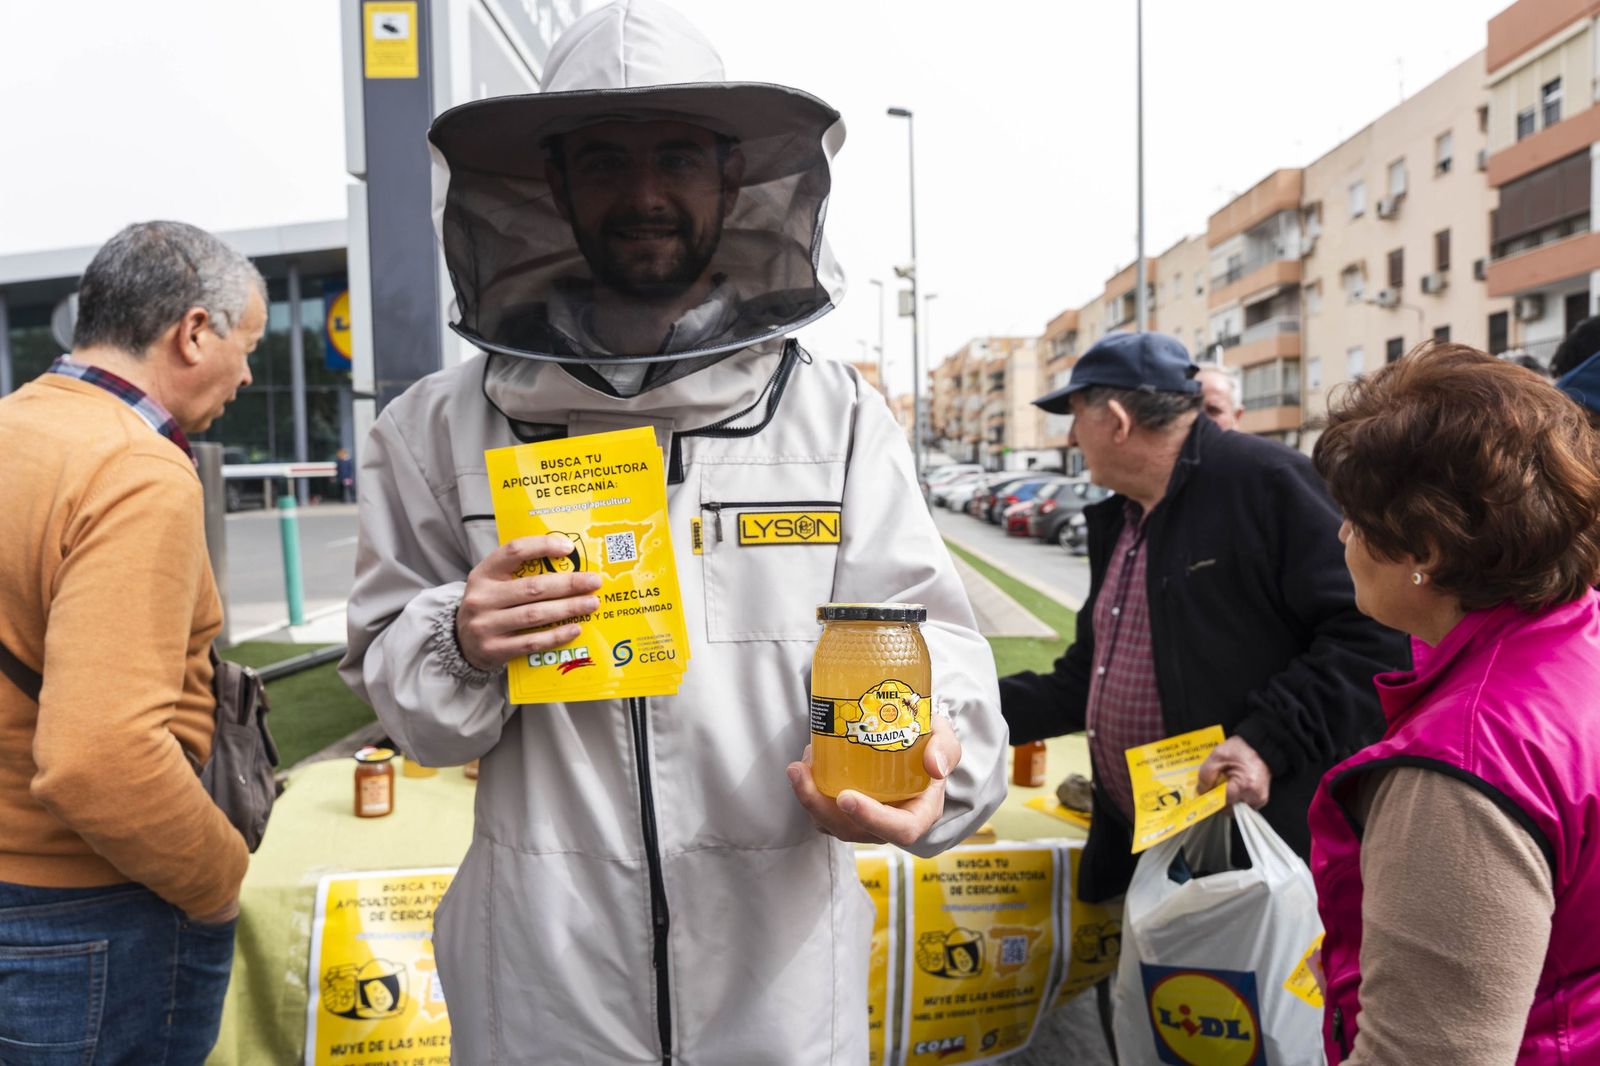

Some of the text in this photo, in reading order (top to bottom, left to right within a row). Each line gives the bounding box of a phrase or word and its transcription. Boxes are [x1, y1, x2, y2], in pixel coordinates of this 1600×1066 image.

[541, 453, 602, 470] BUSCA TU
[502, 462, 649, 489] APICULTOR/APICULTORA
[536, 477, 619, 499] DE CERCANÍA:
[528, 496, 631, 517] www.coag.org/apicultura
[742, 514, 838, 541] LYSON
[604, 587, 661, 604] MEZCLAS
[594, 613, 601, 621] Y
[603, 611, 615, 620] DE
[617, 603, 673, 618] PROXIMIDAD
[528, 646, 590, 668] COAG
[639, 649, 676, 664] CECU
[876, 691, 900, 699] MIEL
[863, 730, 905, 743] ALBAIDA
[390, 910, 433, 921] CERCA
